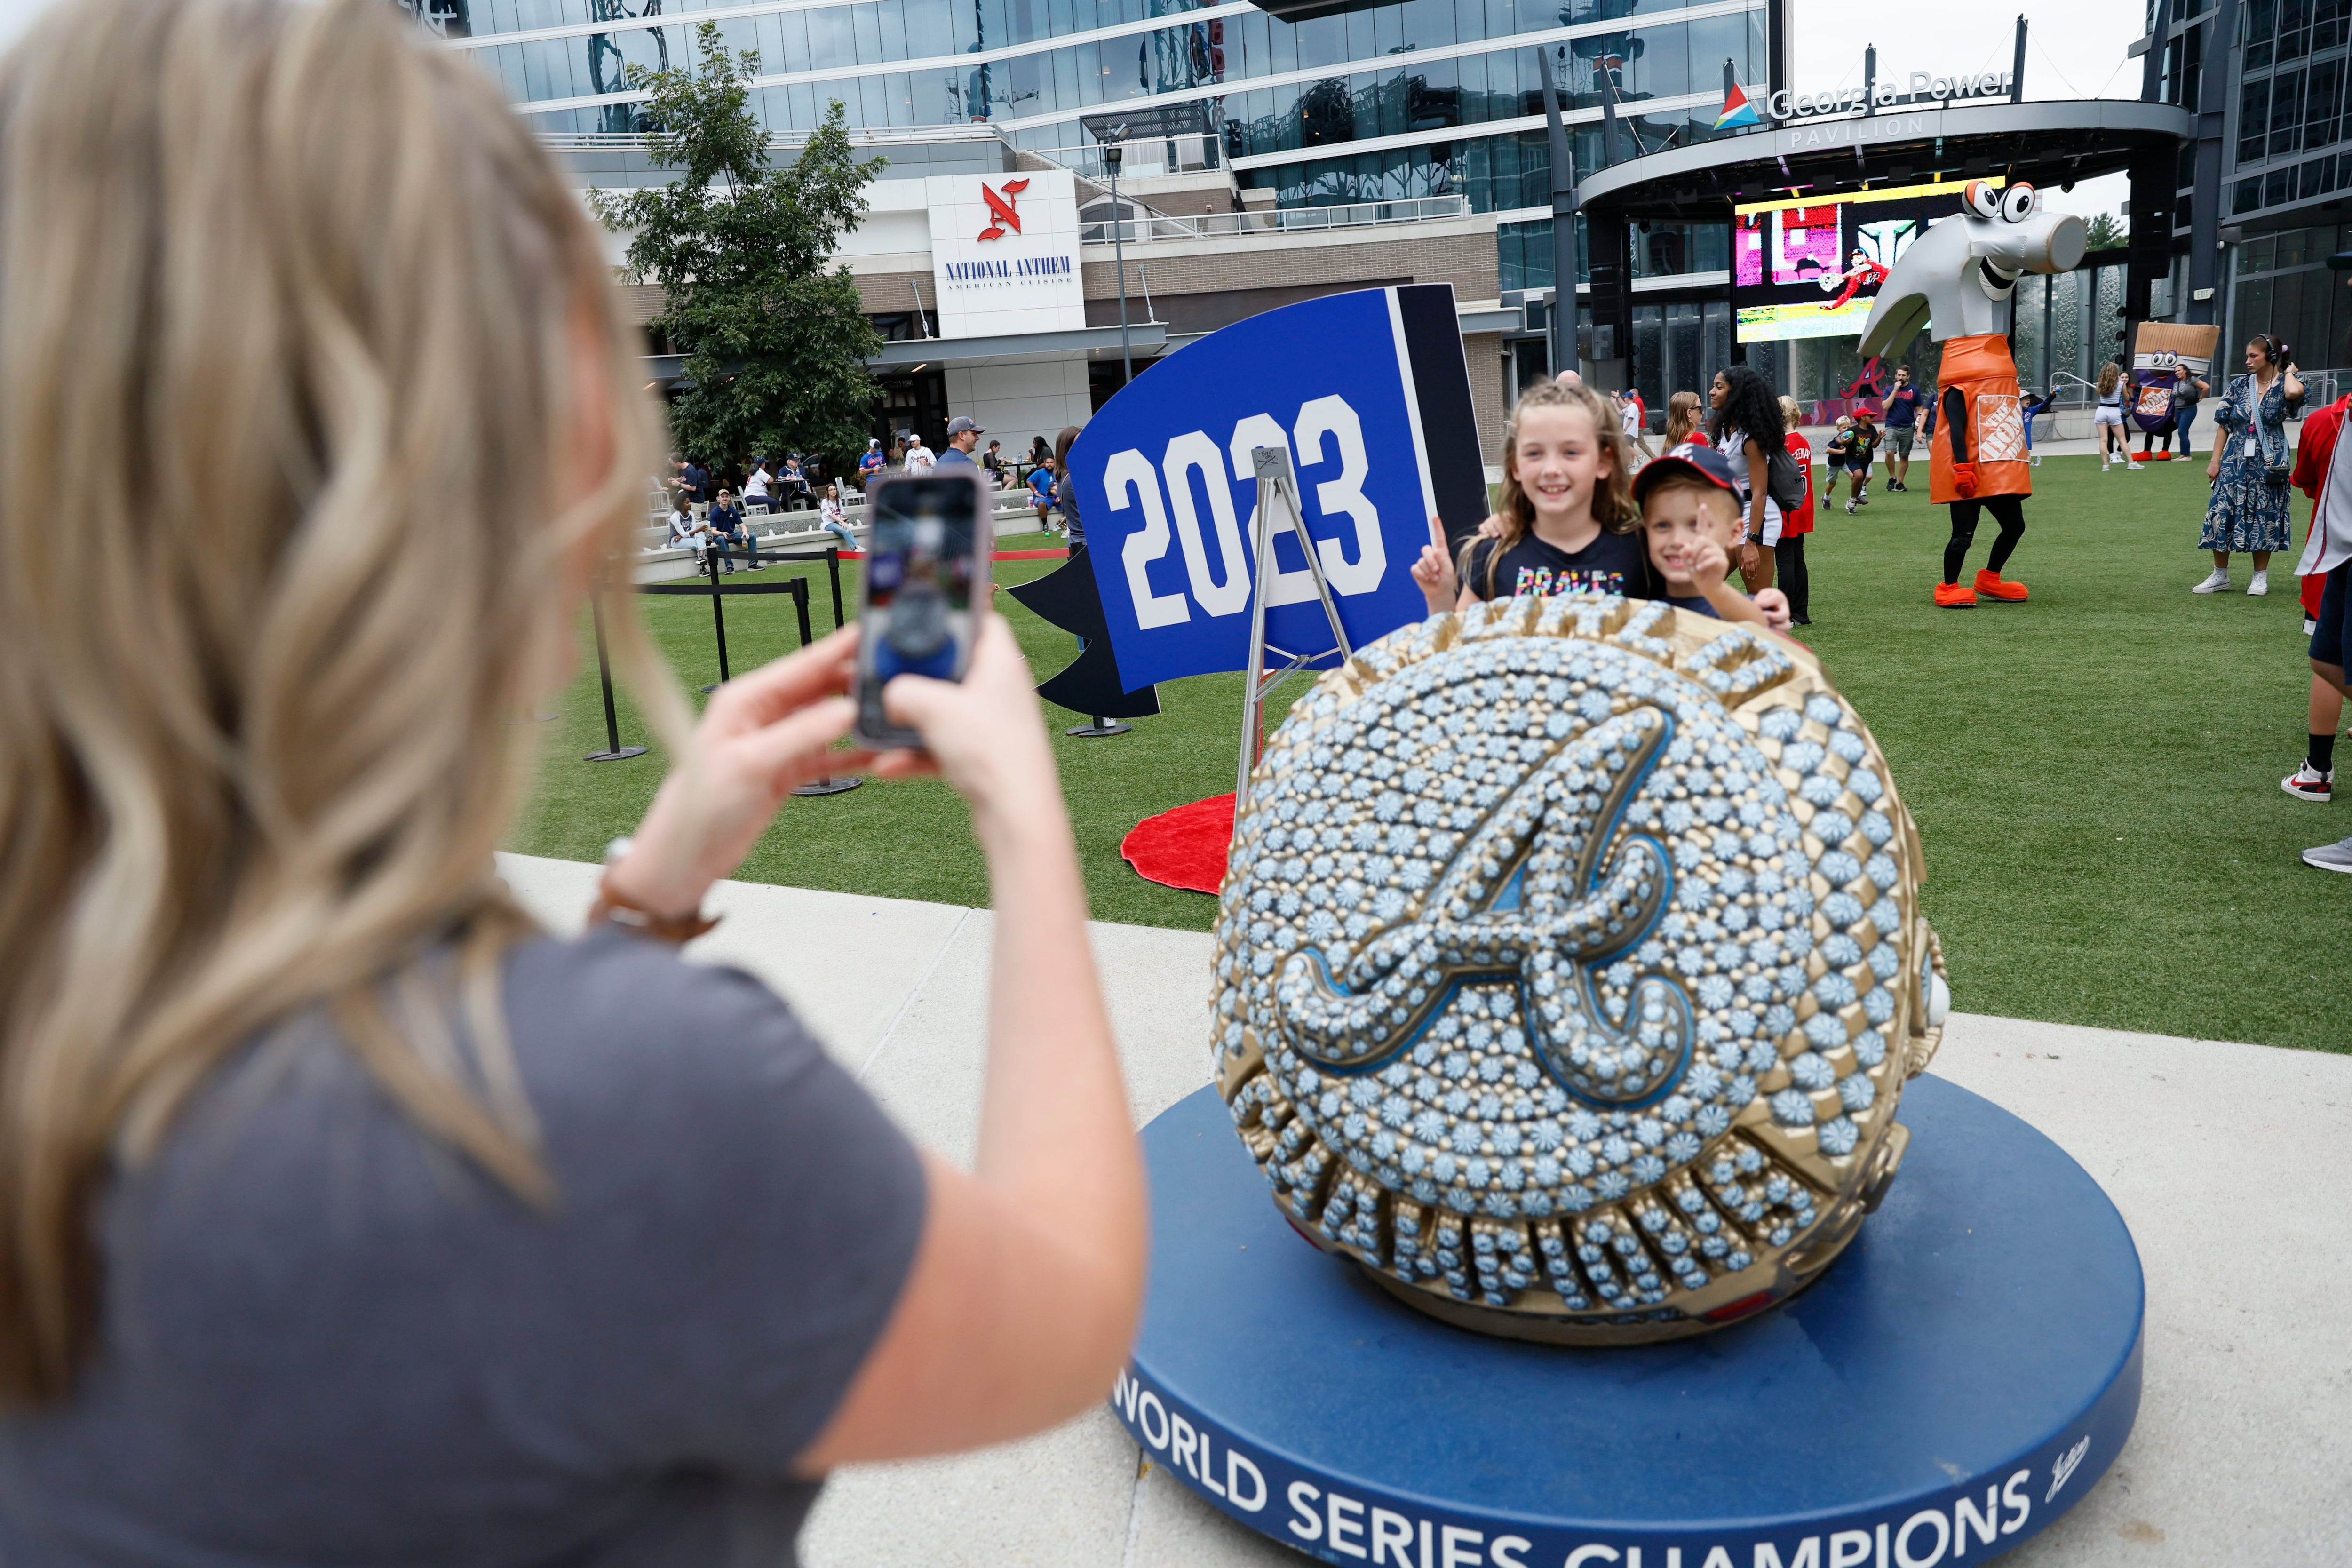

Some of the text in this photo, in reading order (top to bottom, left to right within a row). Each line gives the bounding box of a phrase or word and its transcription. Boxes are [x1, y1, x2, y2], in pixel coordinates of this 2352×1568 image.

[1769, 71, 2015, 120] Georgia Power
[1791, 117, 1923, 149] PAVILION
[946, 256, 1070, 281] NATIONAL ANTHEM
[947, 277, 1073, 291] AMERICAN CUISINE
[2197, 290, 2209, 299] EXIT
[2138, 390, 2169, 412] HOME
[2143, 390, 2157, 400] THE
[1986, 404, 2011, 427] THE
[1980, 401, 2024, 459] HOM
[1103, 394, 1387, 630] 2023
[1113, 1366, 1267, 1512] WORLD
